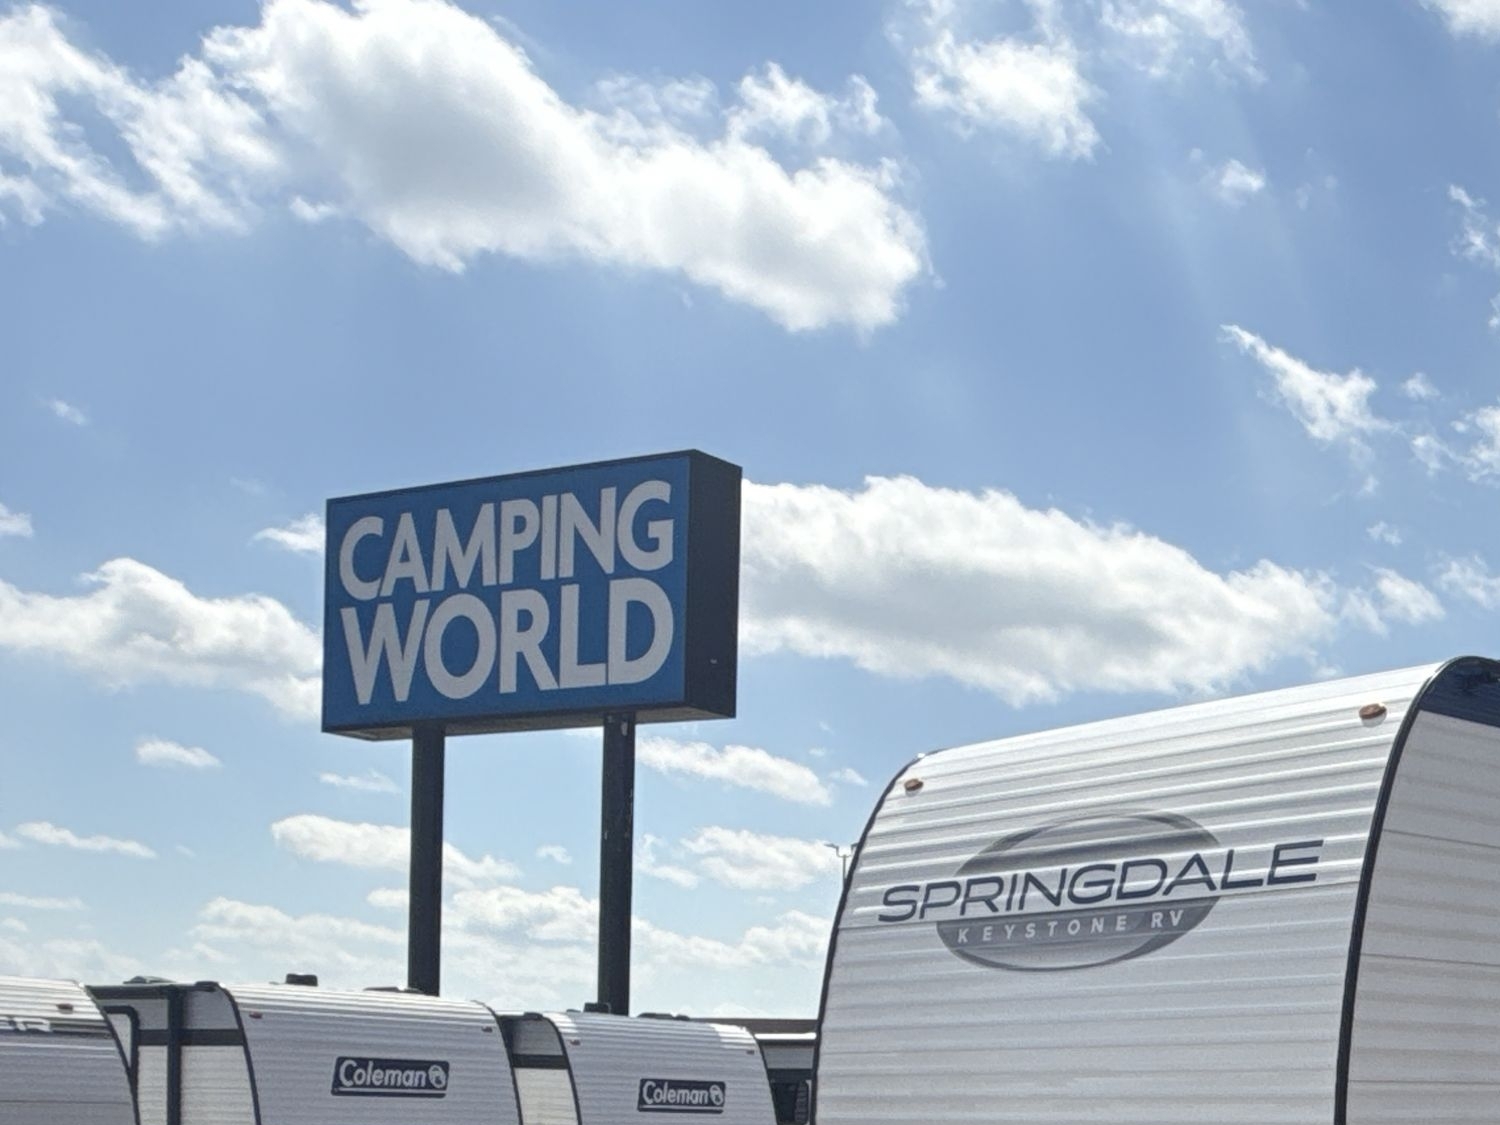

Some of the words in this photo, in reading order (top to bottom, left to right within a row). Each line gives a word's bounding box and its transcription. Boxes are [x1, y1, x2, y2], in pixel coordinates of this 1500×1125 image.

[339, 479, 675, 601] CAMPING
[340, 577, 674, 706] WORLD
[877, 839, 1325, 923] SPRINGDALE
[957, 914, 1128, 943] KEYSTONE
[1151, 909, 1185, 930] RV
[339, 1059, 427, 1088] Coleman
[642, 1080, 709, 1105] Coleman
